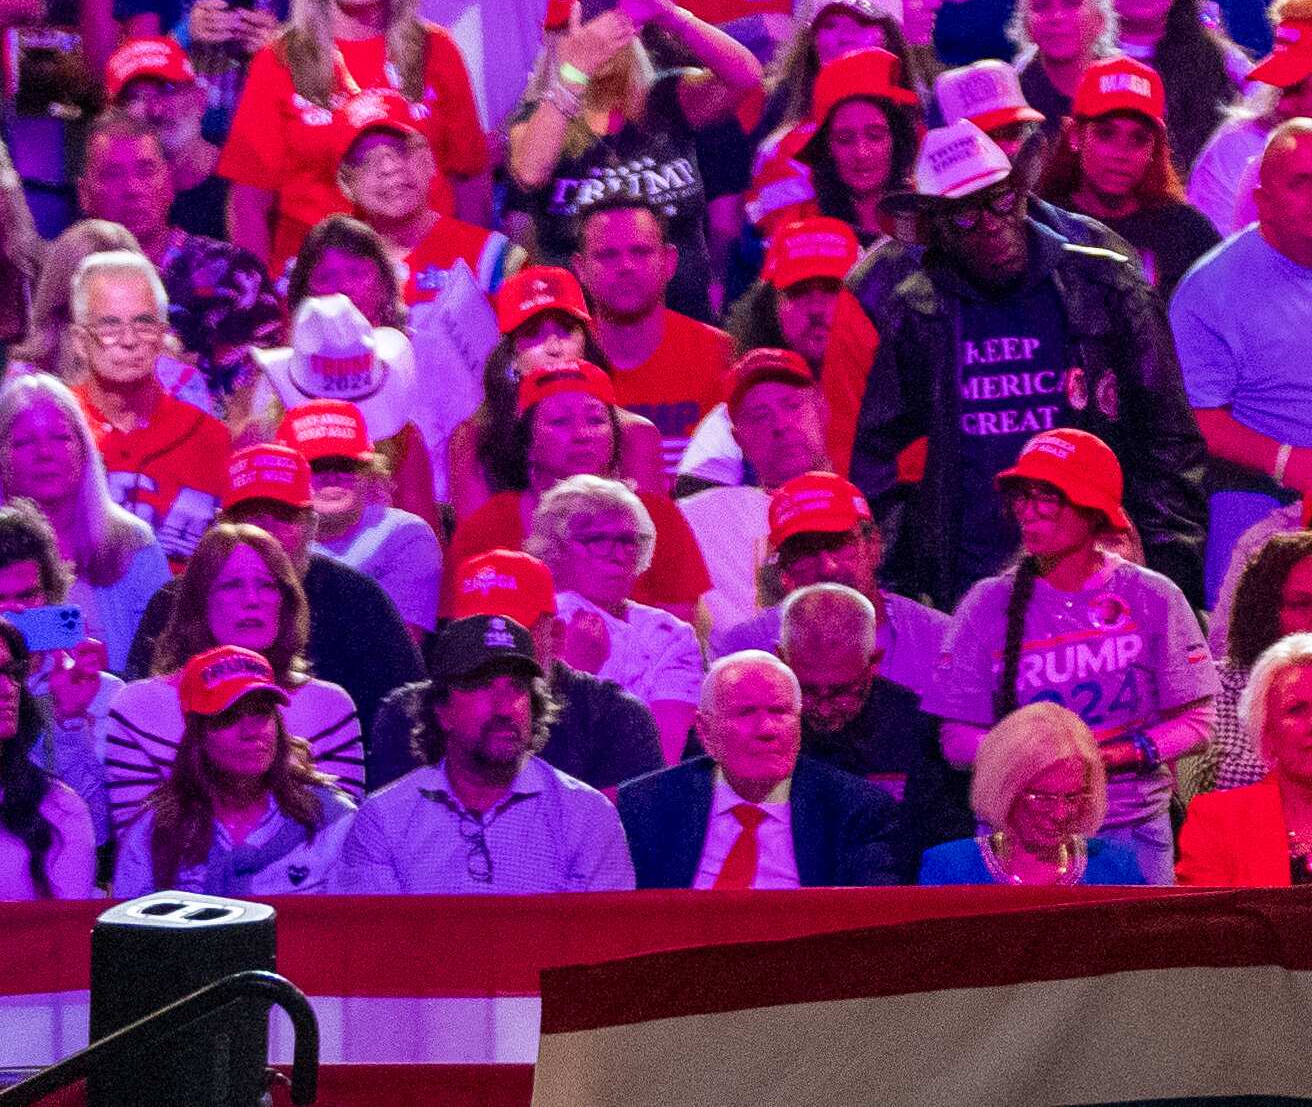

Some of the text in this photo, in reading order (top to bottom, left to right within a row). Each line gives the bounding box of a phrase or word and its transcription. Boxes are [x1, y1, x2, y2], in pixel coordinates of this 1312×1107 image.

[555, 156, 698, 208] TRUMP
[963, 336, 1041, 365] KEEP
[959, 369, 1069, 402] MERIC
[959, 405, 1060, 438] GREAT
[1017, 633, 1143, 692] RUMP
